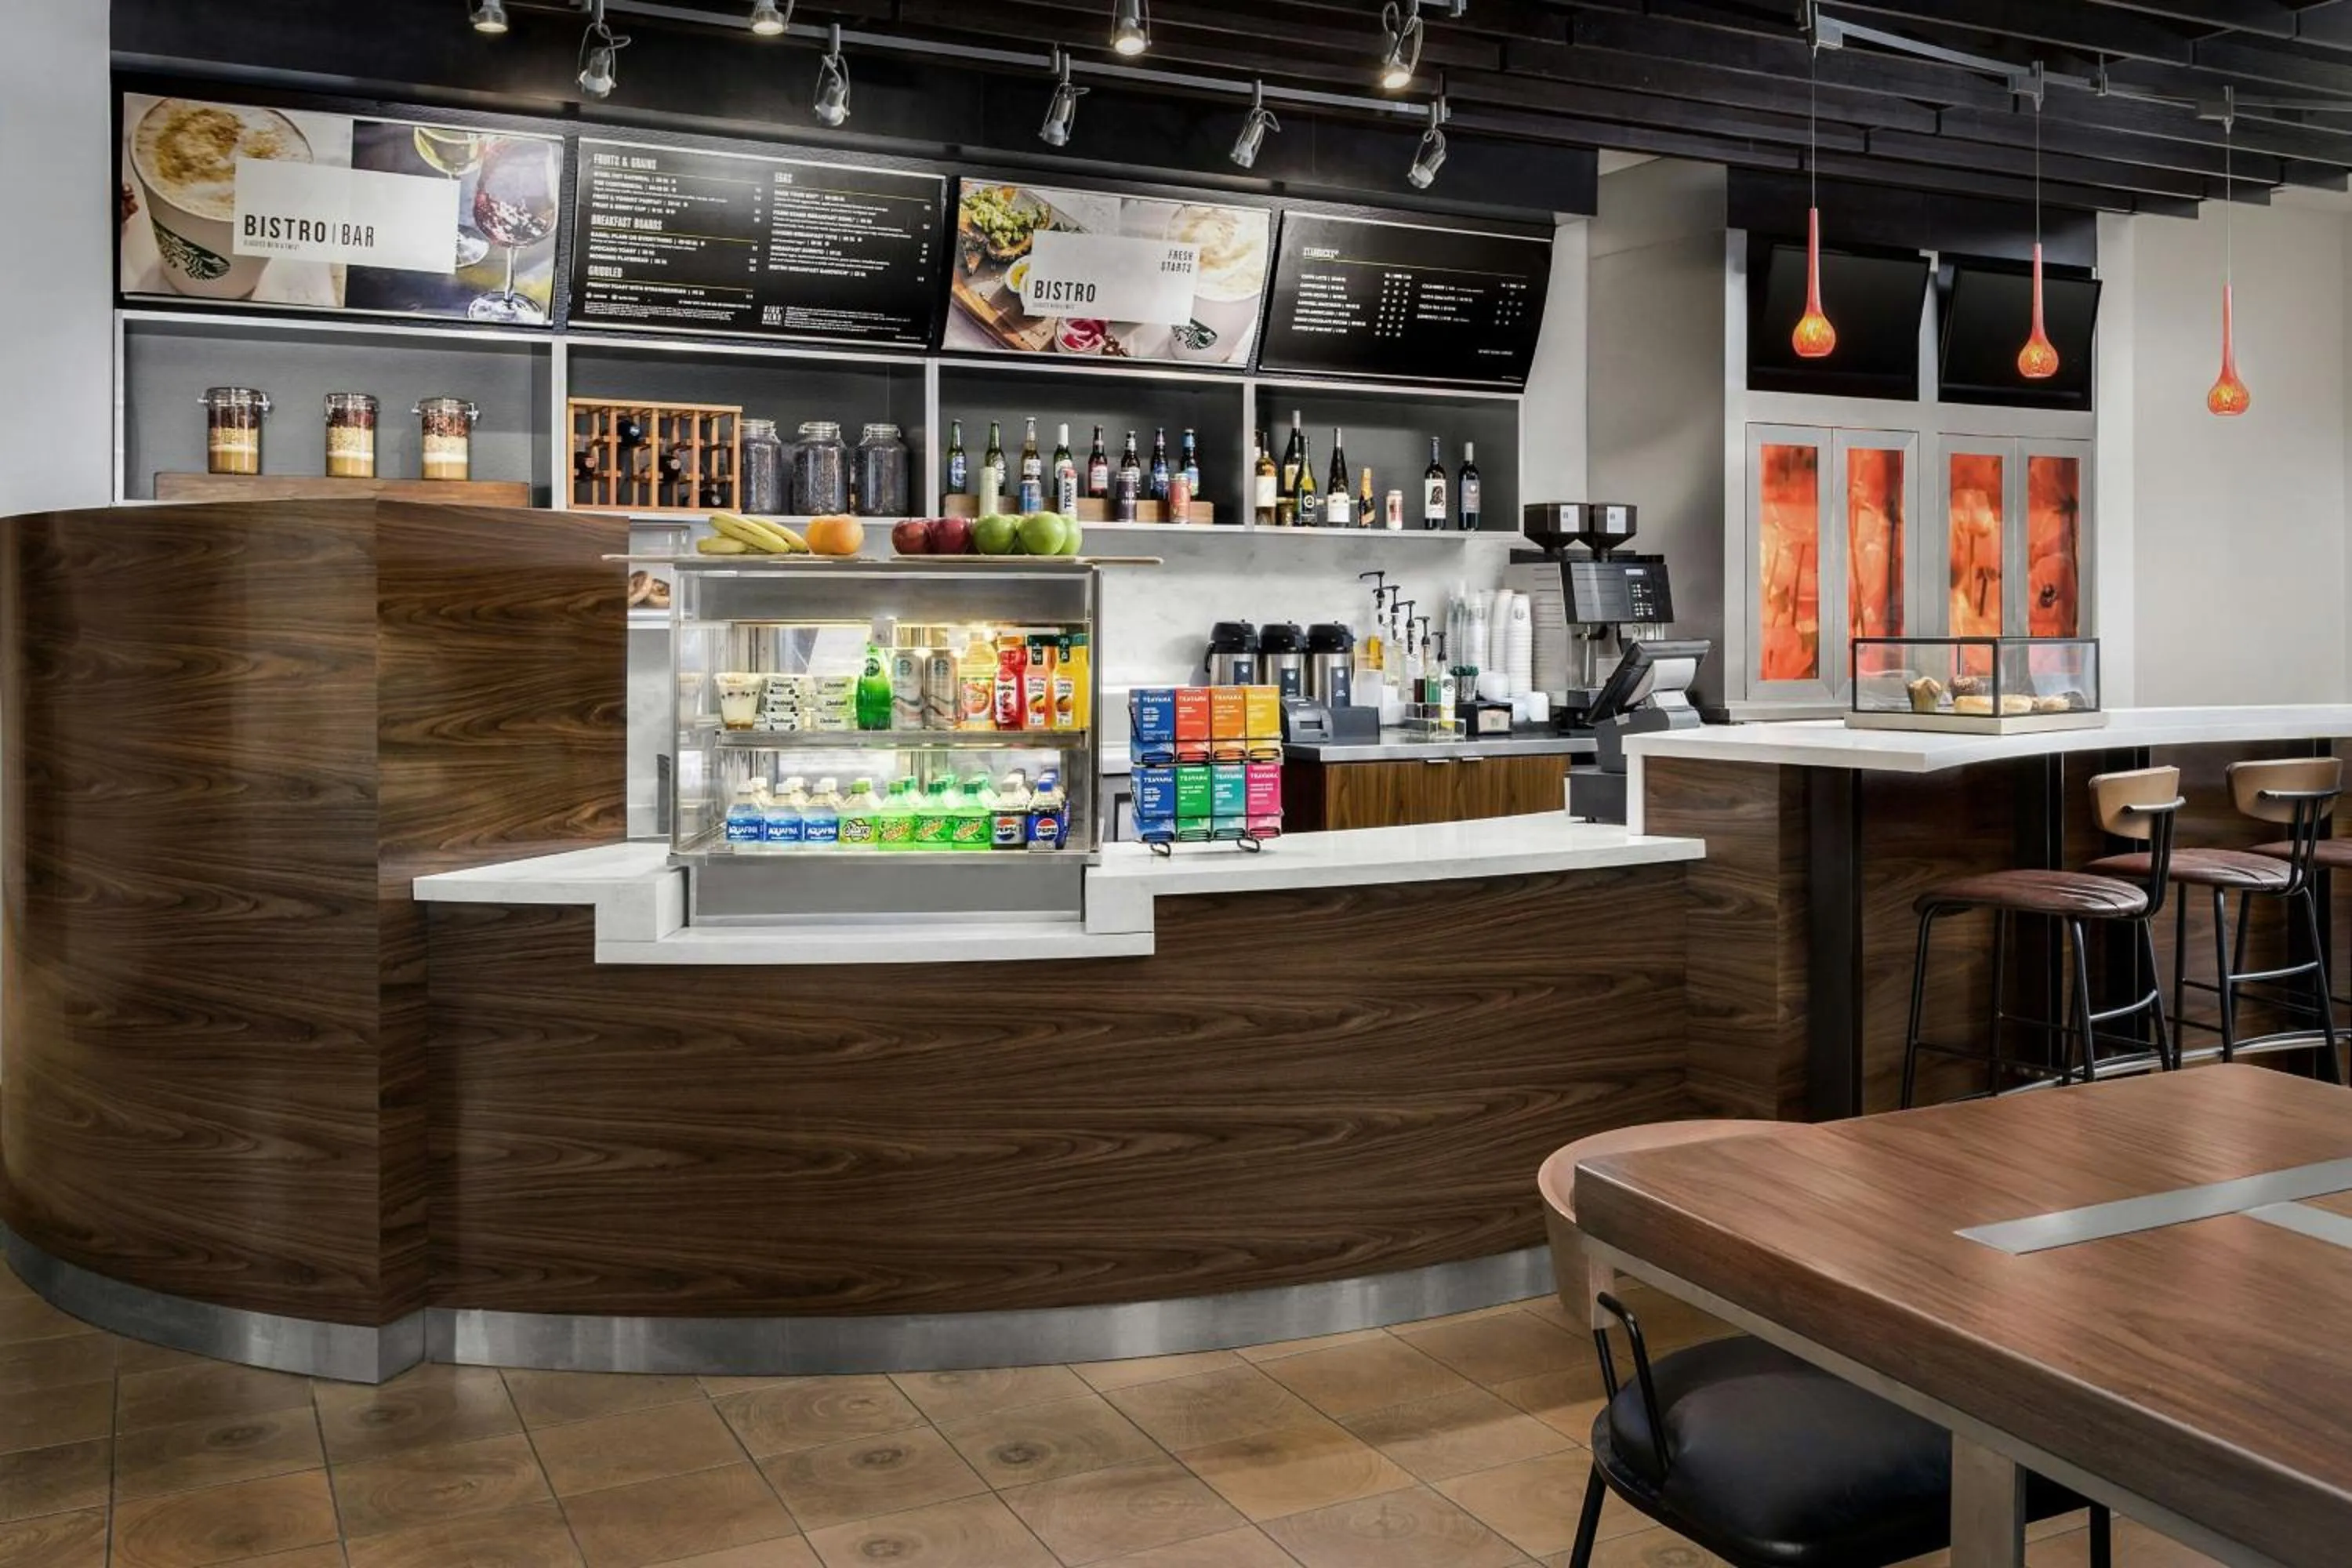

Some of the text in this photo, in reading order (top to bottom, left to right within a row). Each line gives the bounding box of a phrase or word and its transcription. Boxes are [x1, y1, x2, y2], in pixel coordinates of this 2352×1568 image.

[591, 214, 631, 228] BREAKFAST
[244, 214, 375, 248] BISTRO BAR
[1168, 249, 1193, 261] FRESH
[1160, 261, 1192, 274] STARTS
[1034, 280, 1096, 303] BISTRO
